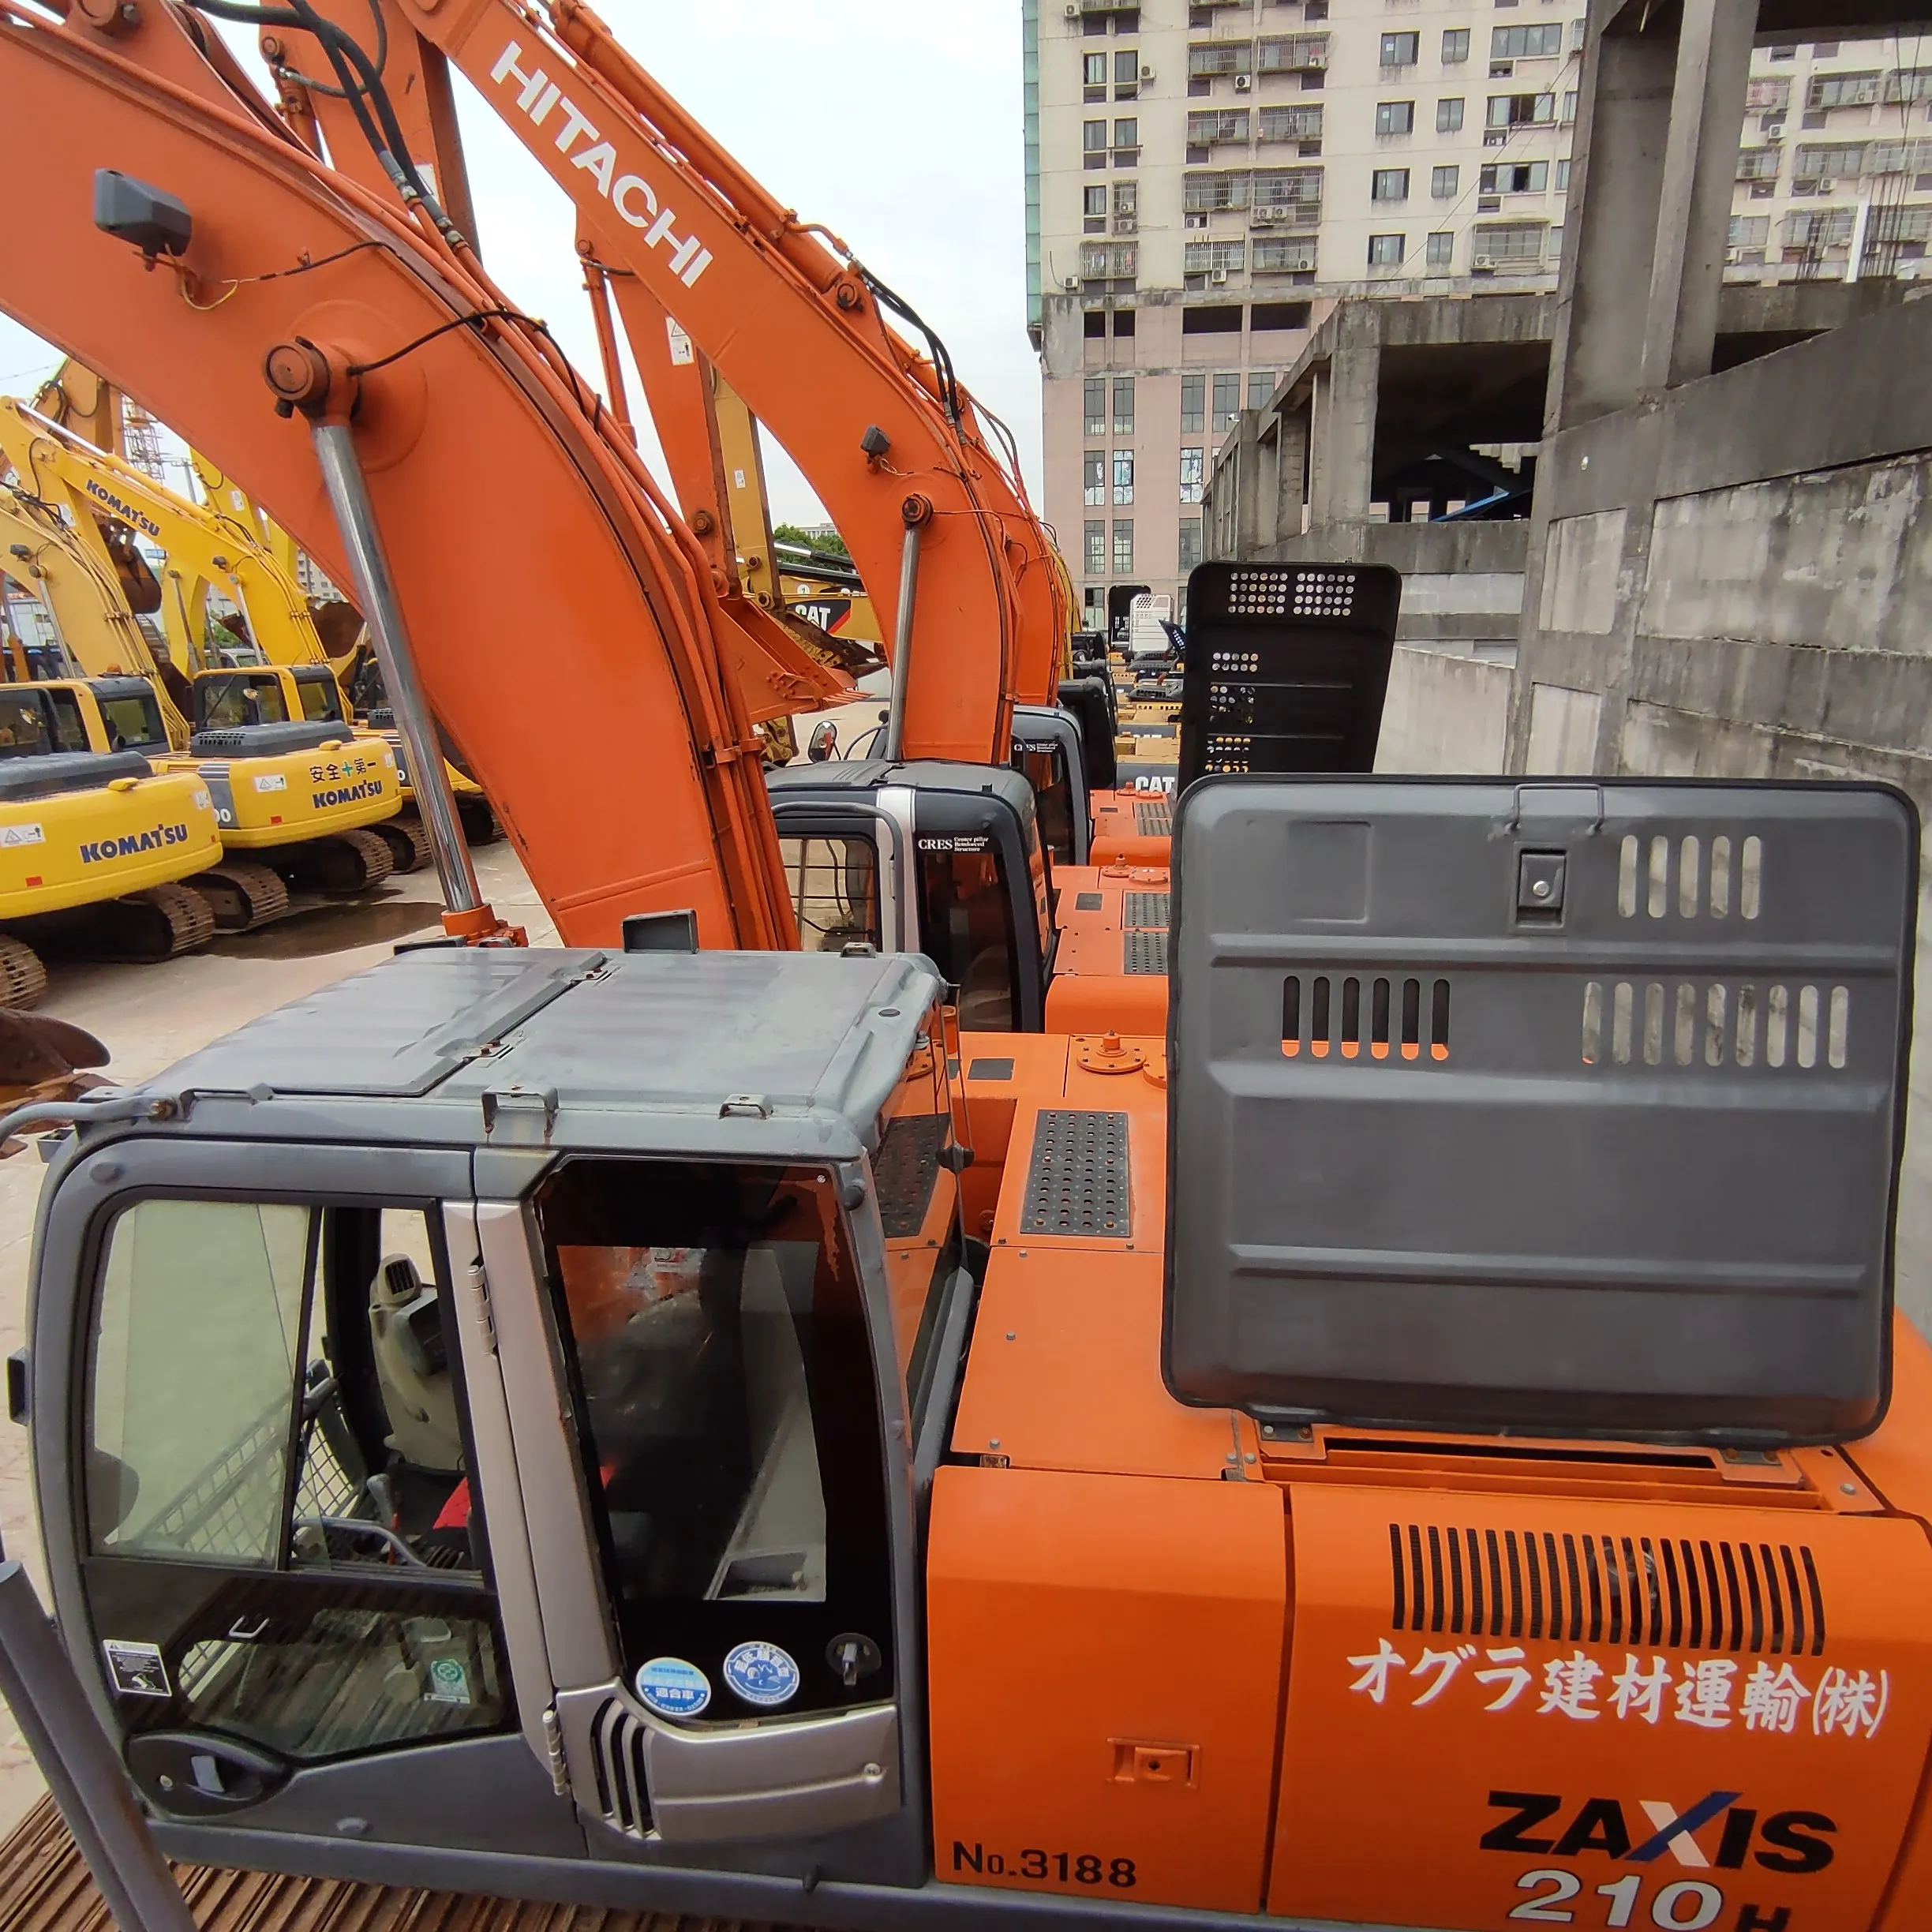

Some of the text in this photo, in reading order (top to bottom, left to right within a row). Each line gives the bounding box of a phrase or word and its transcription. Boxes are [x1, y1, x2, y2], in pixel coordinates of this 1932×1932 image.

[490, 40, 713, 288] HITACHI
[1135, 776, 1175, 794] CAT
[918, 839, 953, 850] CRES
[1480, 1790, 1837, 1874] ZAXIS
